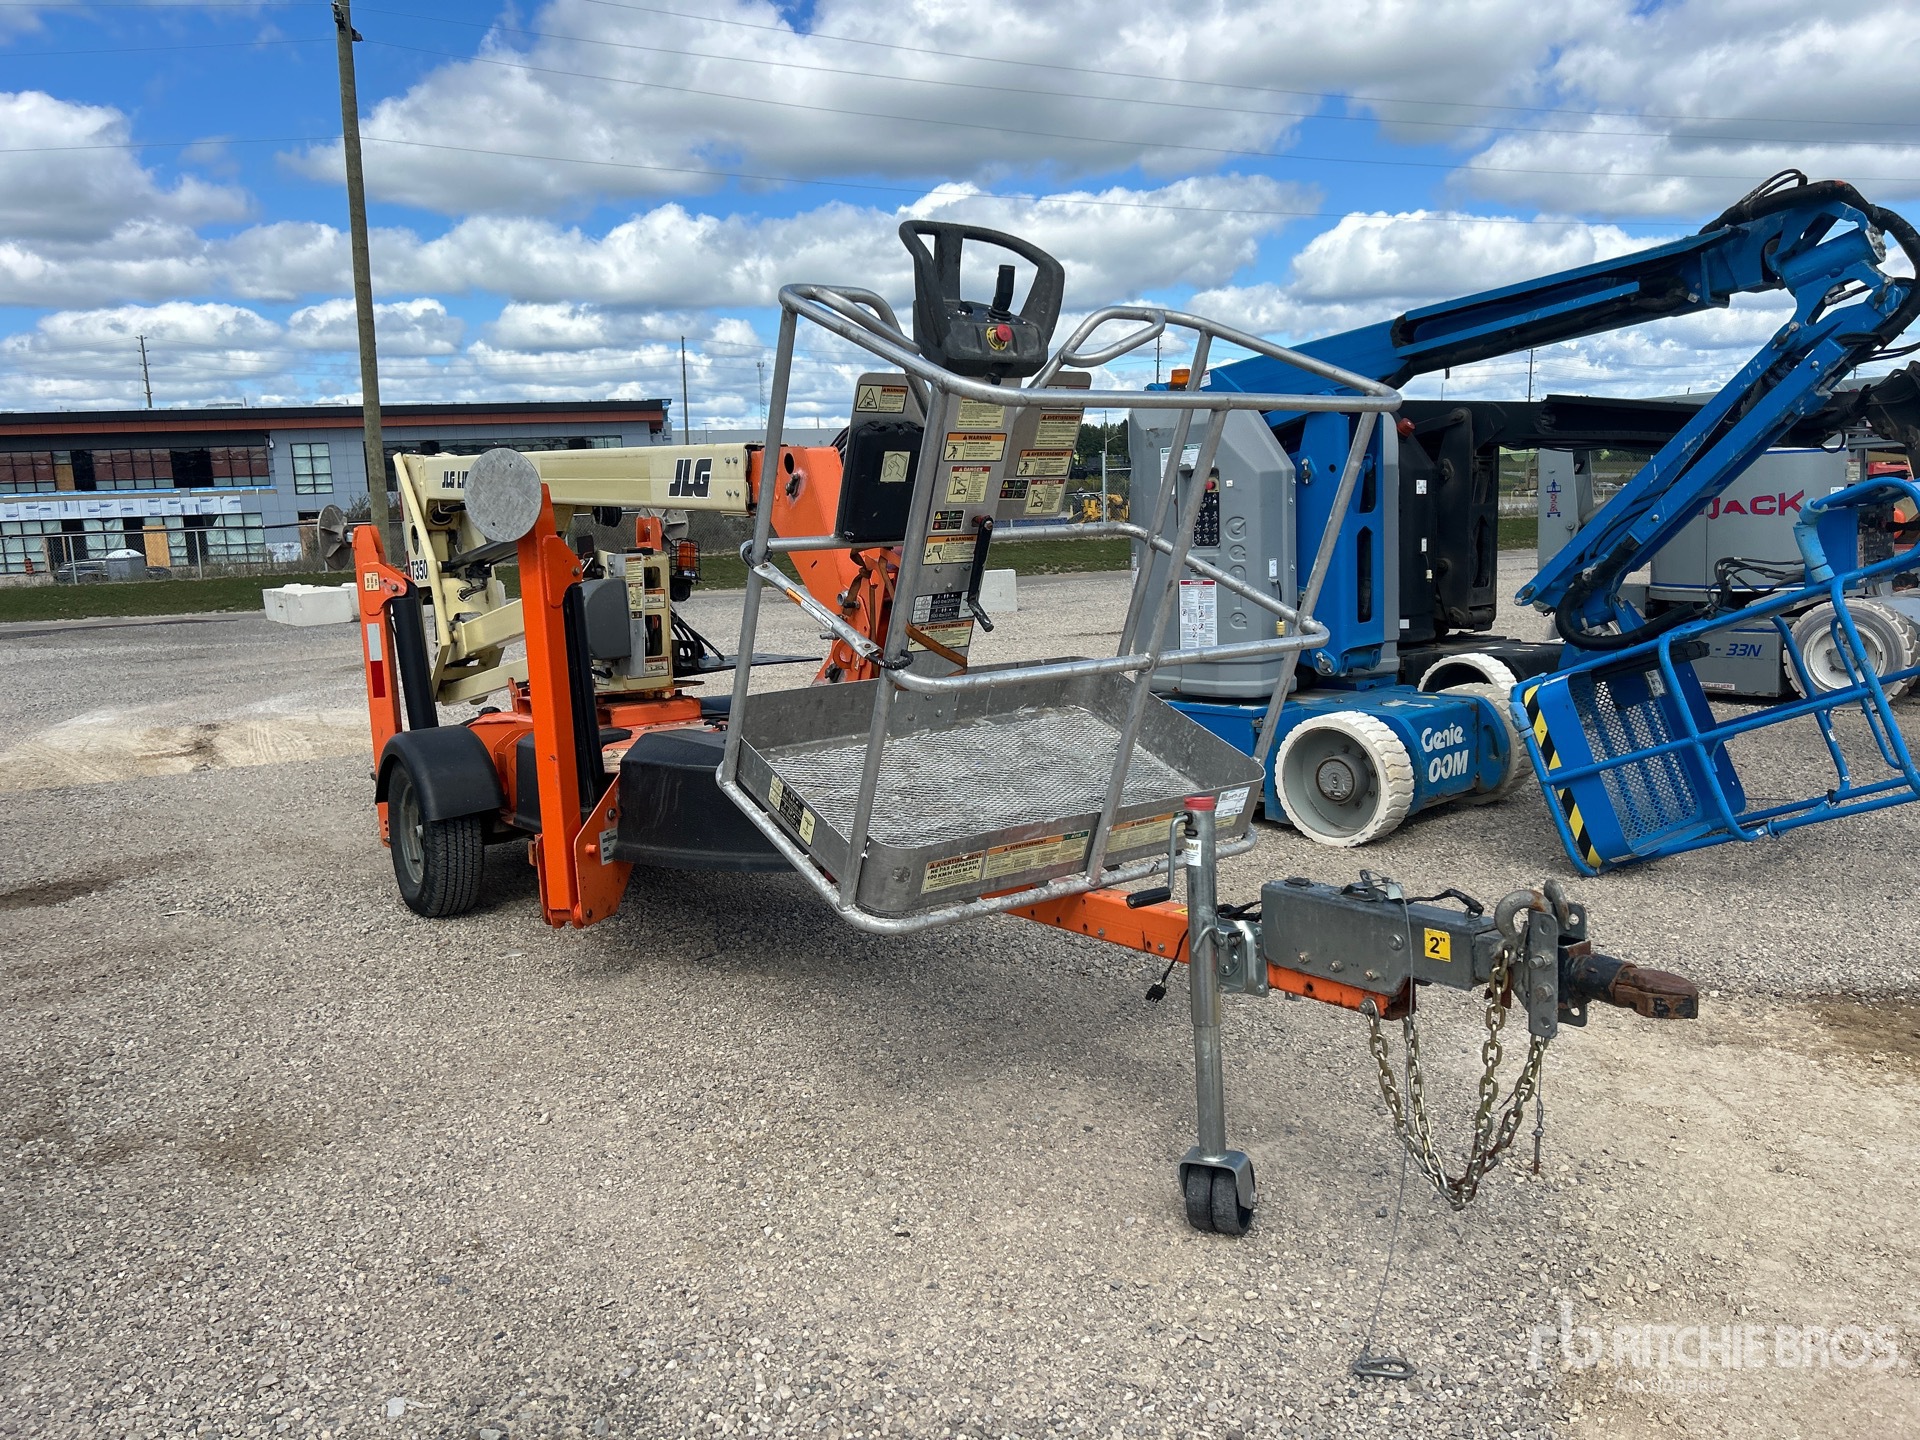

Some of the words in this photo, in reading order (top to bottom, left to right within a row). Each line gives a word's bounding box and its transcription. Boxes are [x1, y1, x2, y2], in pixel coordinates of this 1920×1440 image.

[441, 470, 455, 489] JLG
[668, 458, 712, 498] JLG
[1698, 489, 1804, 520] JACK
[410, 559, 428, 581] T350
[1726, 643, 1762, 657] 33N
[1421, 722, 1463, 753] Genie
[1430, 936, 1445, 954] 2"
